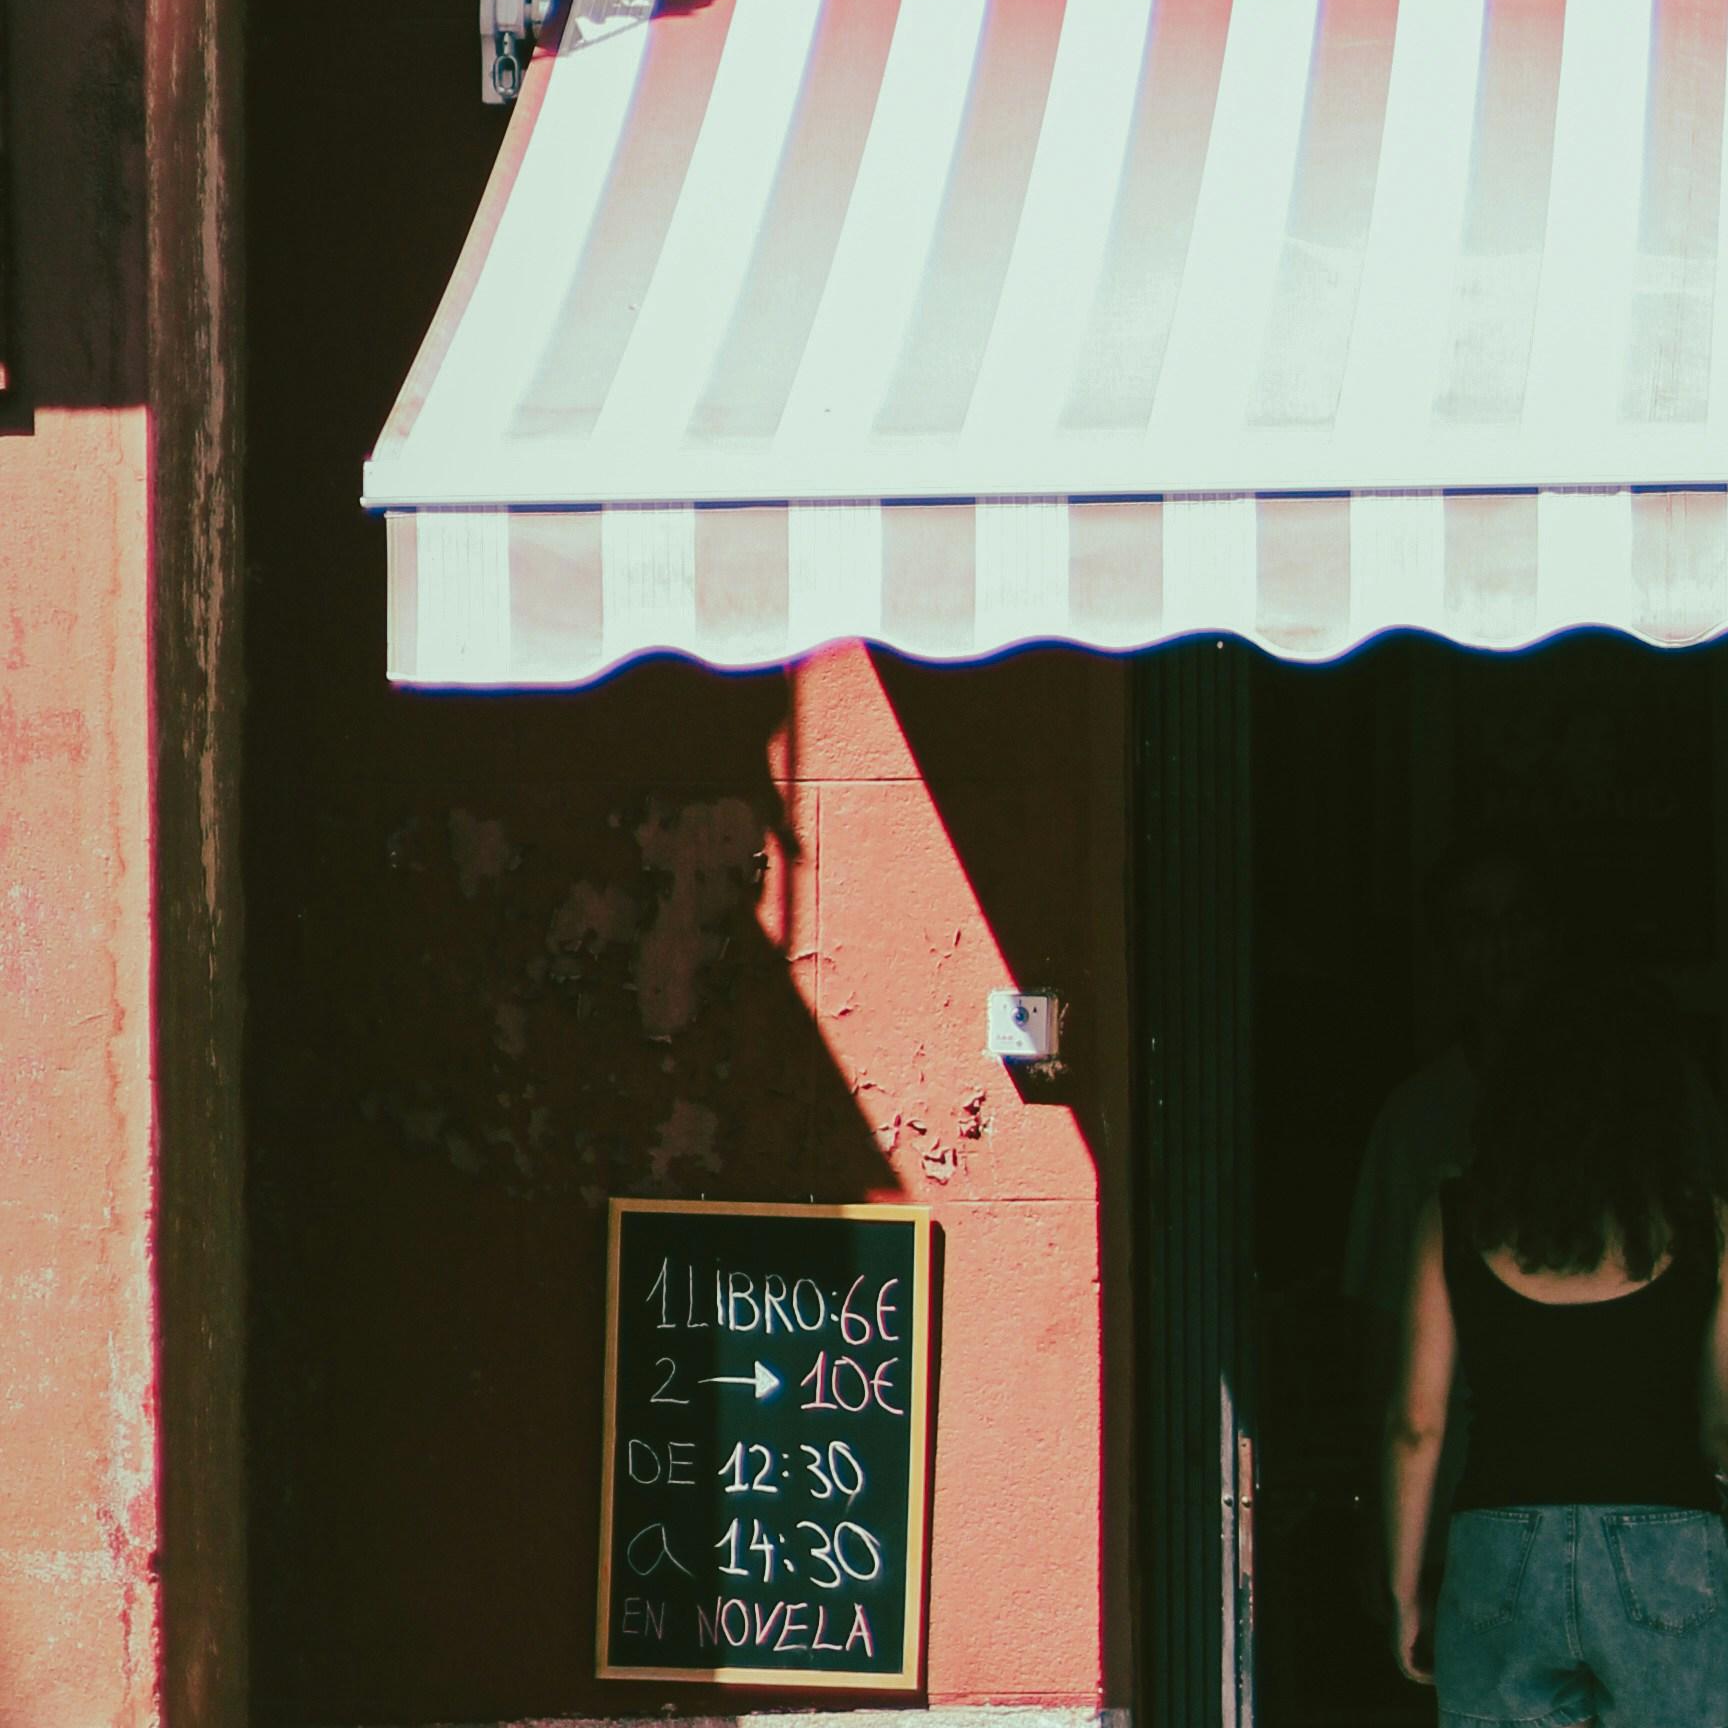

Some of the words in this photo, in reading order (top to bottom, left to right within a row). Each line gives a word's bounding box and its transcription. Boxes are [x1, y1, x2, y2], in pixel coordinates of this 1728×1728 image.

[646, 1257, 676, 1329] 1
[650, 1357, 690, 1404] 2
[800, 1351, 904, 1415] 10€
[629, 1439, 696, 1484] DE
[718, 1441, 863, 1498] 12:30
[714, 1518, 880, 1588] 14:30
[623, 1597, 665, 1640] EN
[697, 1596, 873, 1658] NOVELA
